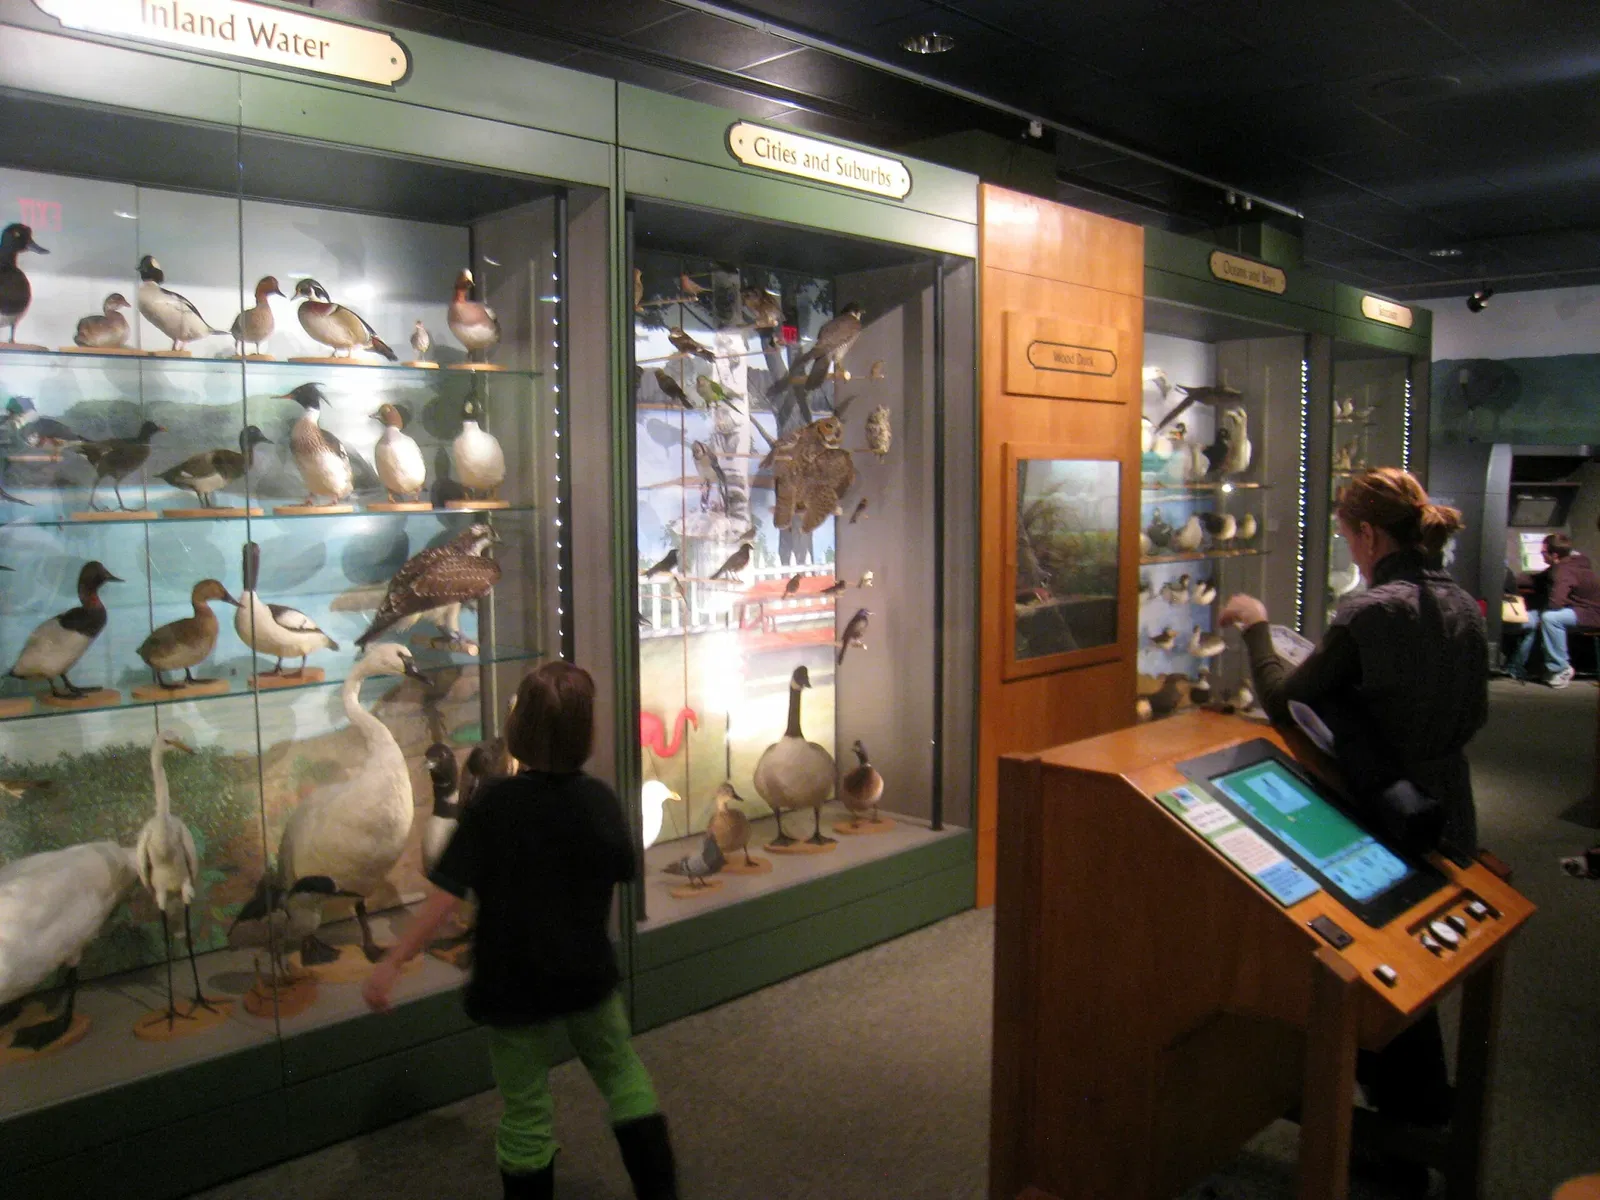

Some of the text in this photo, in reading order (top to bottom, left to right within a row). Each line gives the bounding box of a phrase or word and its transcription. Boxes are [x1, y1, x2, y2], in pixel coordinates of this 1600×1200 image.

[140, 0, 330, 60] Inland Water
[754, 136, 892, 187] Cities and Suburbs
